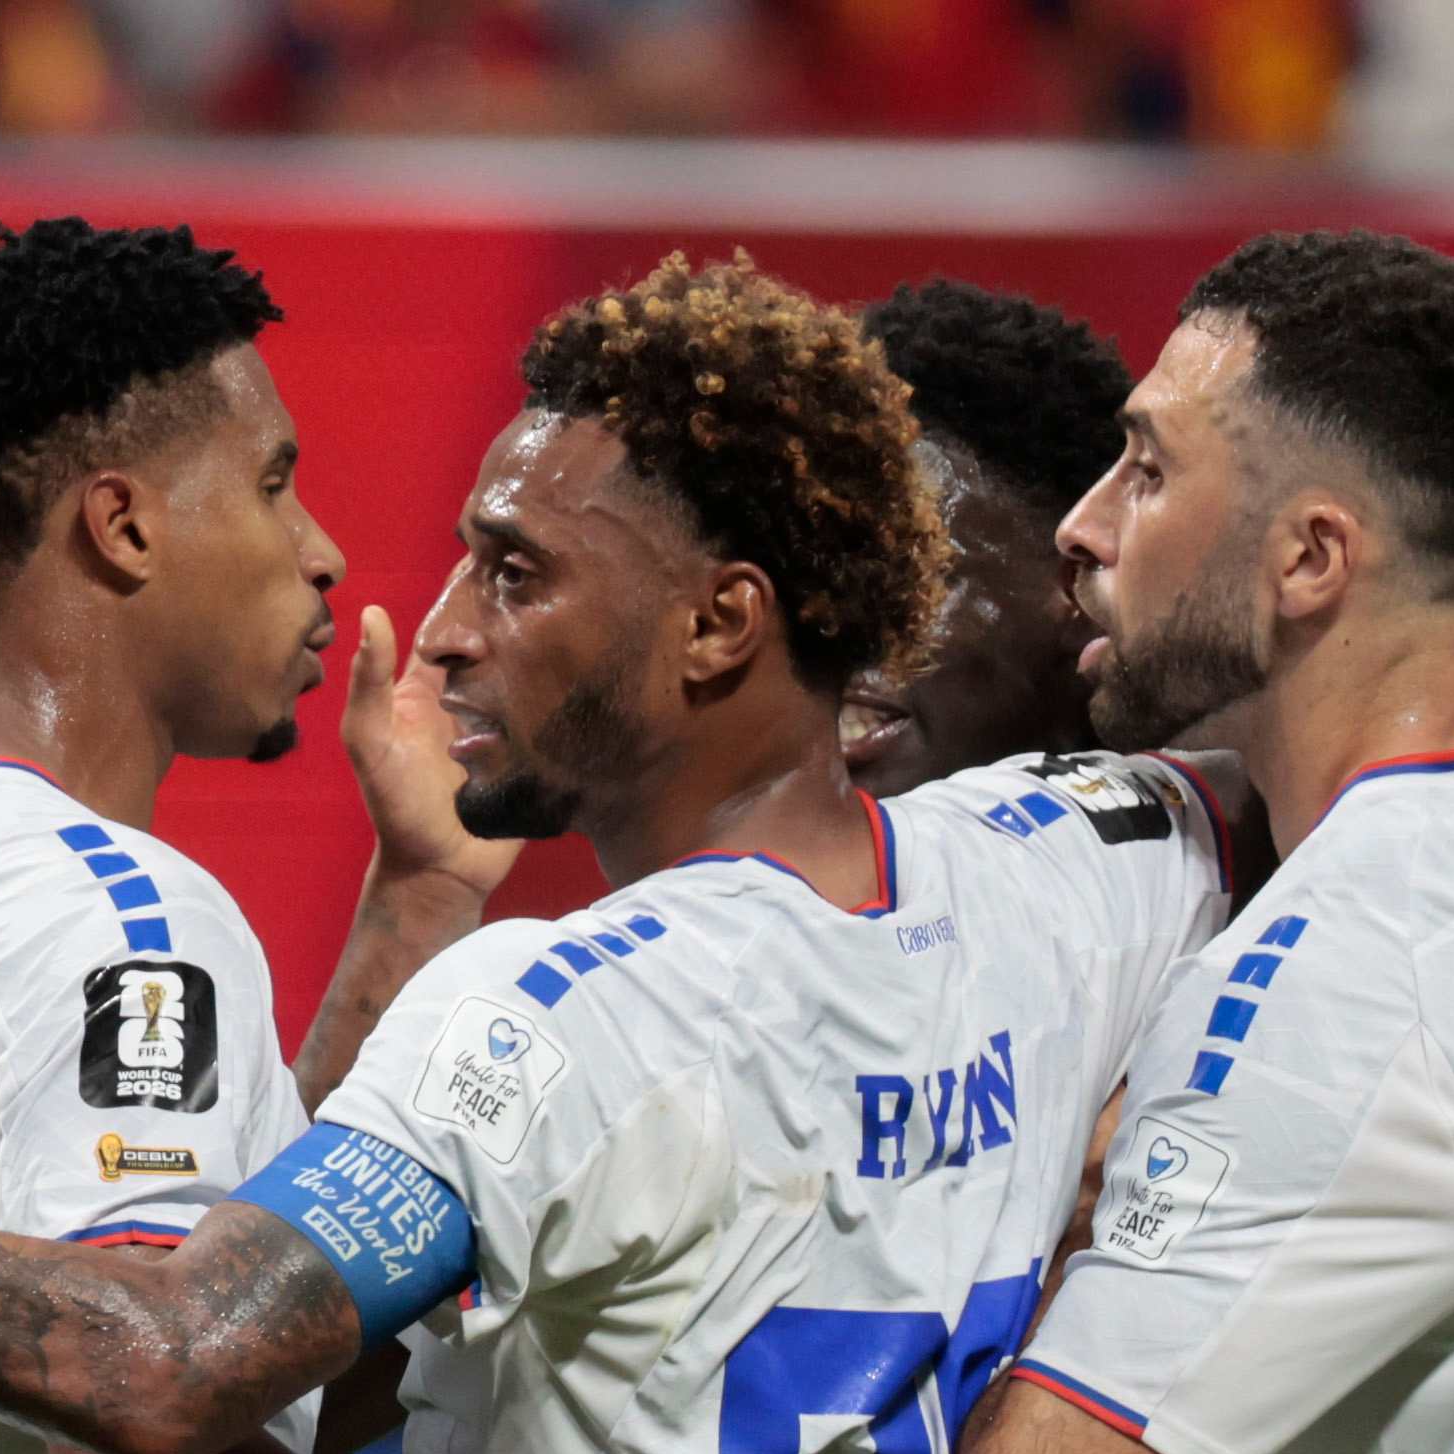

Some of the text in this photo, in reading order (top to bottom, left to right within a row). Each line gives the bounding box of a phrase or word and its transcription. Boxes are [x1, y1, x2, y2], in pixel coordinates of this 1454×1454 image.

[138, 1047, 167, 1058] FIFA
[116, 1080, 182, 1101] 2026
[117, 1069, 183, 1083] WORLD CUP
[454, 1050, 521, 1100] Unite For
[448, 1073, 506, 1126] PEACE
[123, 1150, 188, 1162] DEBUT
[323, 1142, 436, 1256] UNITES
[1152, 1191, 1177, 1214] For
[292, 1167, 412, 1286] the World
[305, 1208, 357, 1258] FIFA
[1115, 1205, 1165, 1241] EACE
